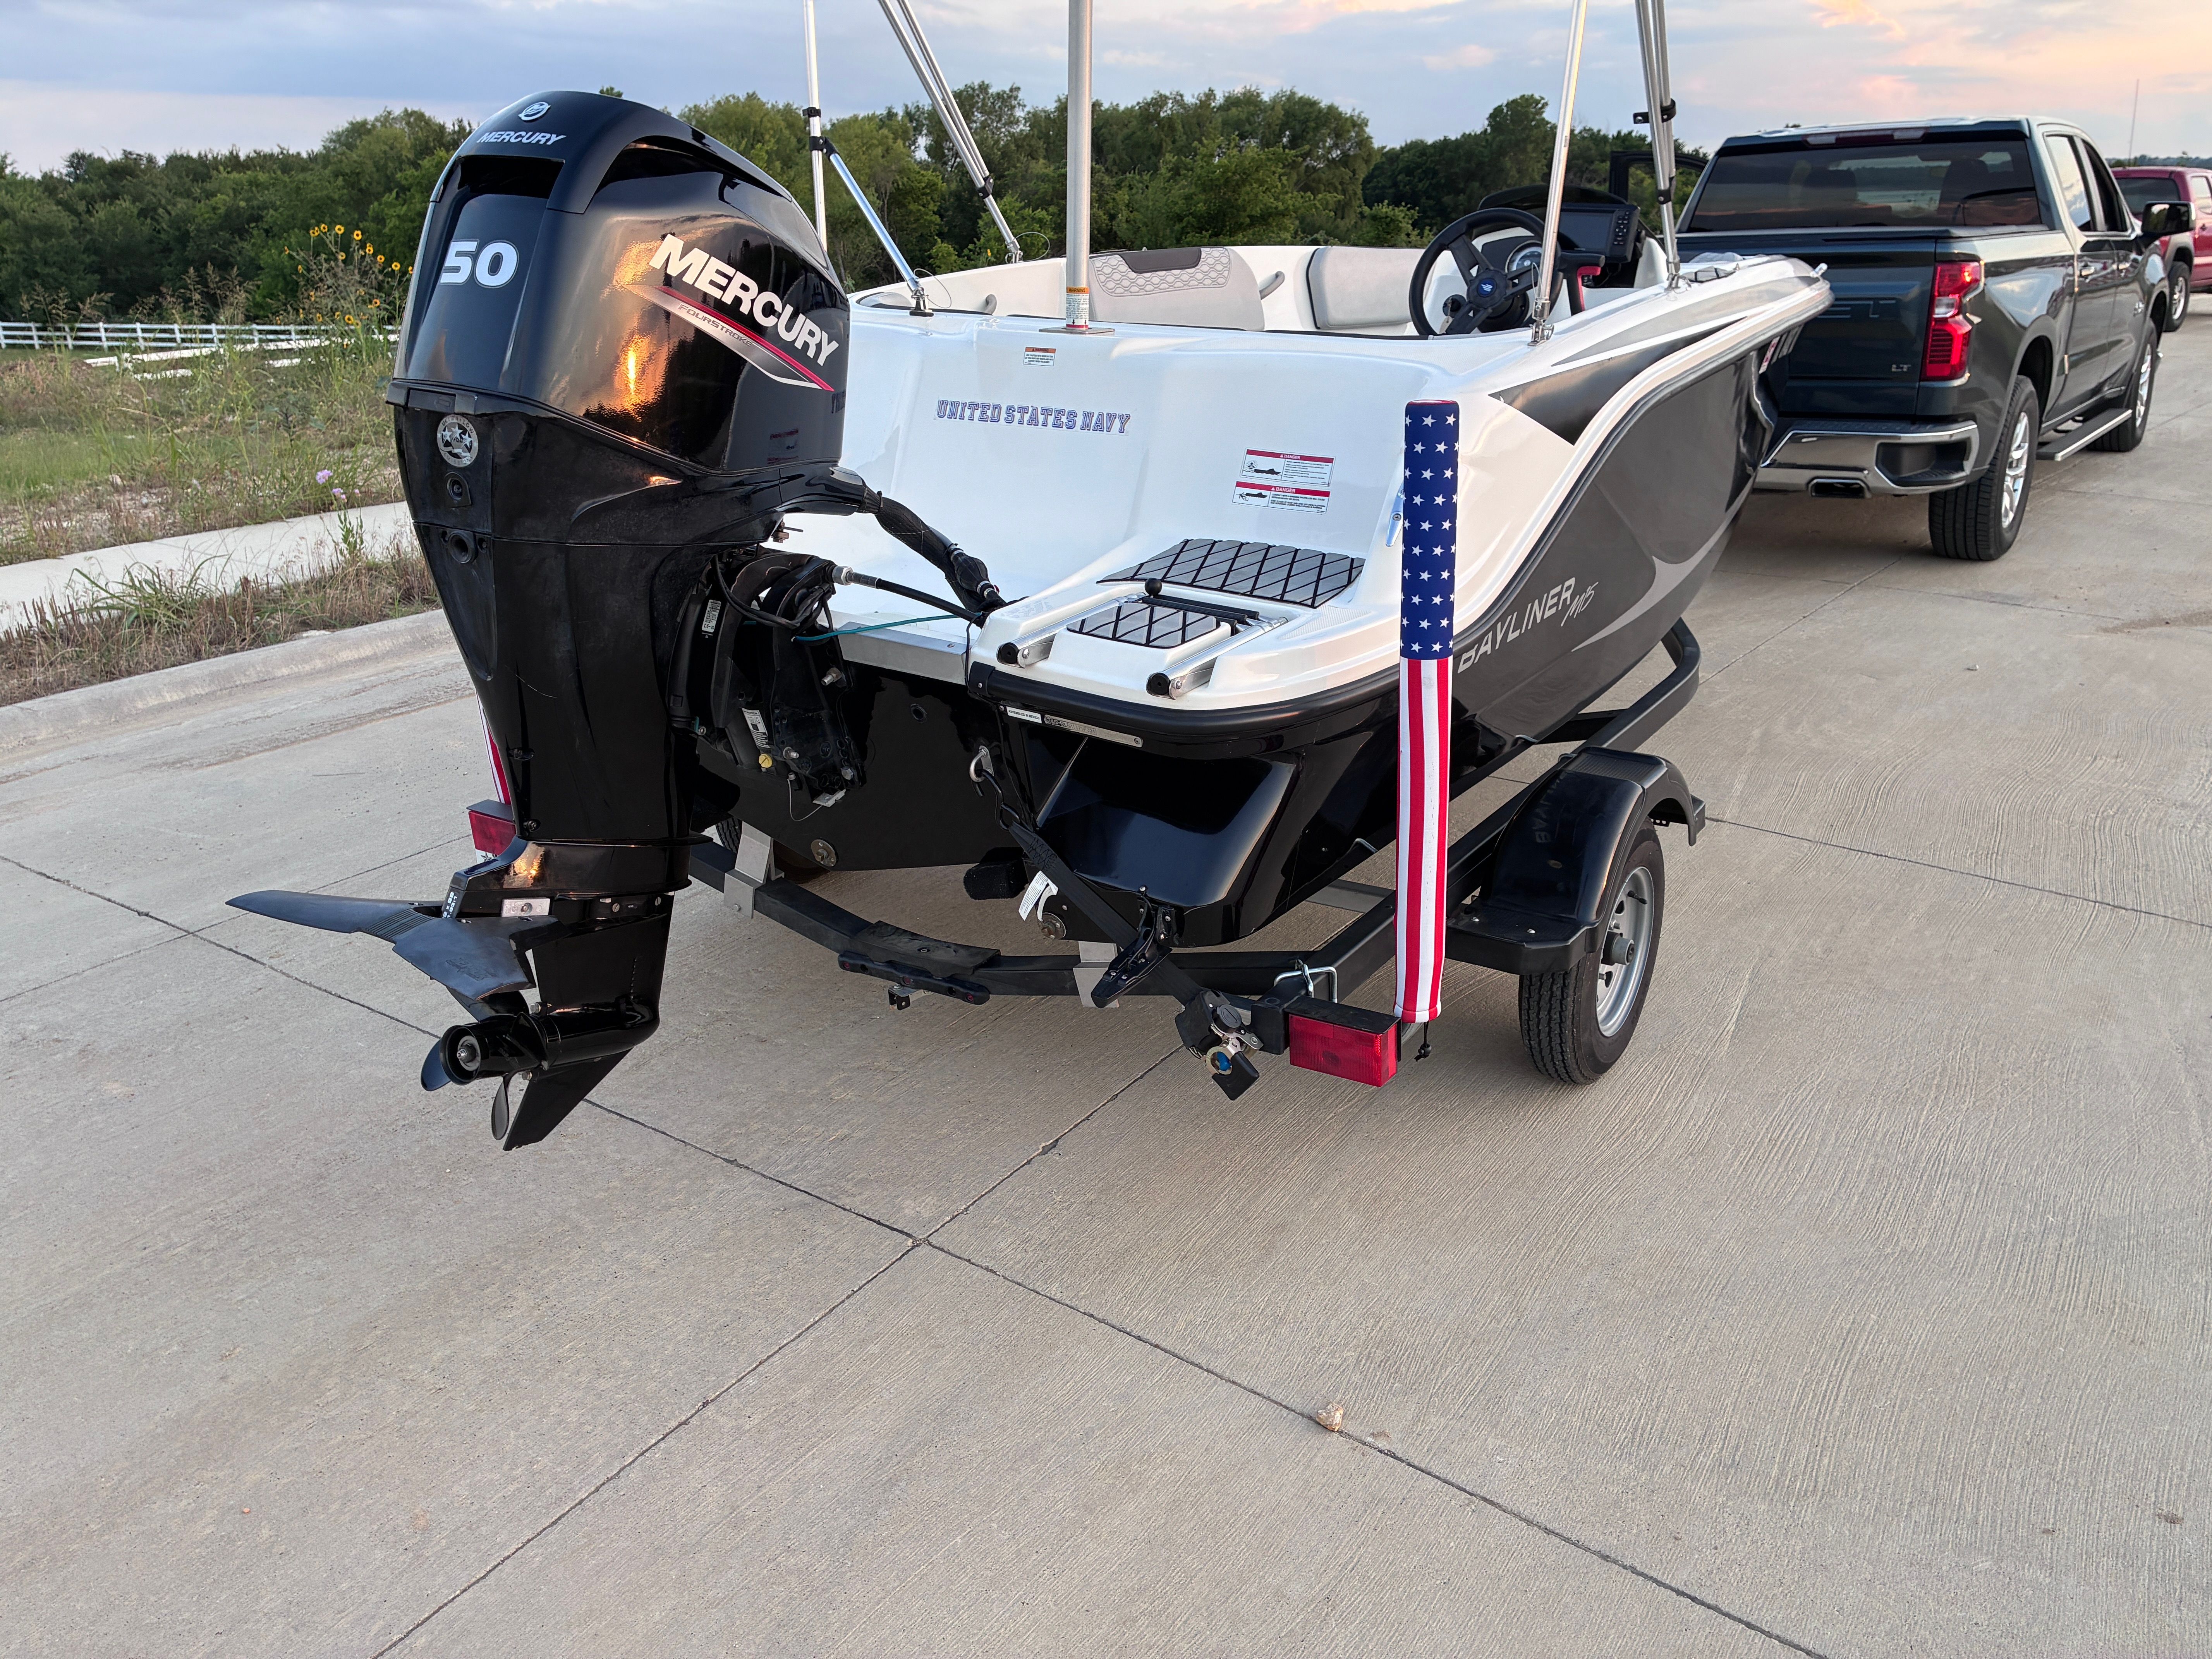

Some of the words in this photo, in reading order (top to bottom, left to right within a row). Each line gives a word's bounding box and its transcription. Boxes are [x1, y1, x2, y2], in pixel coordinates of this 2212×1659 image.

[476, 131, 567, 145] MERCURY
[439, 239, 519, 289] 50
[648, 234, 839, 366] MERCURY
[678, 303, 753, 347] FOURSTROKE
[463, 419, 474, 434] LOW
[936, 399, 1002, 422] UNITED
[1004, 405, 1078, 429] STATES
[1080, 411, 1130, 433] NAVY
[1458, 577, 1575, 674] BAYLINER
